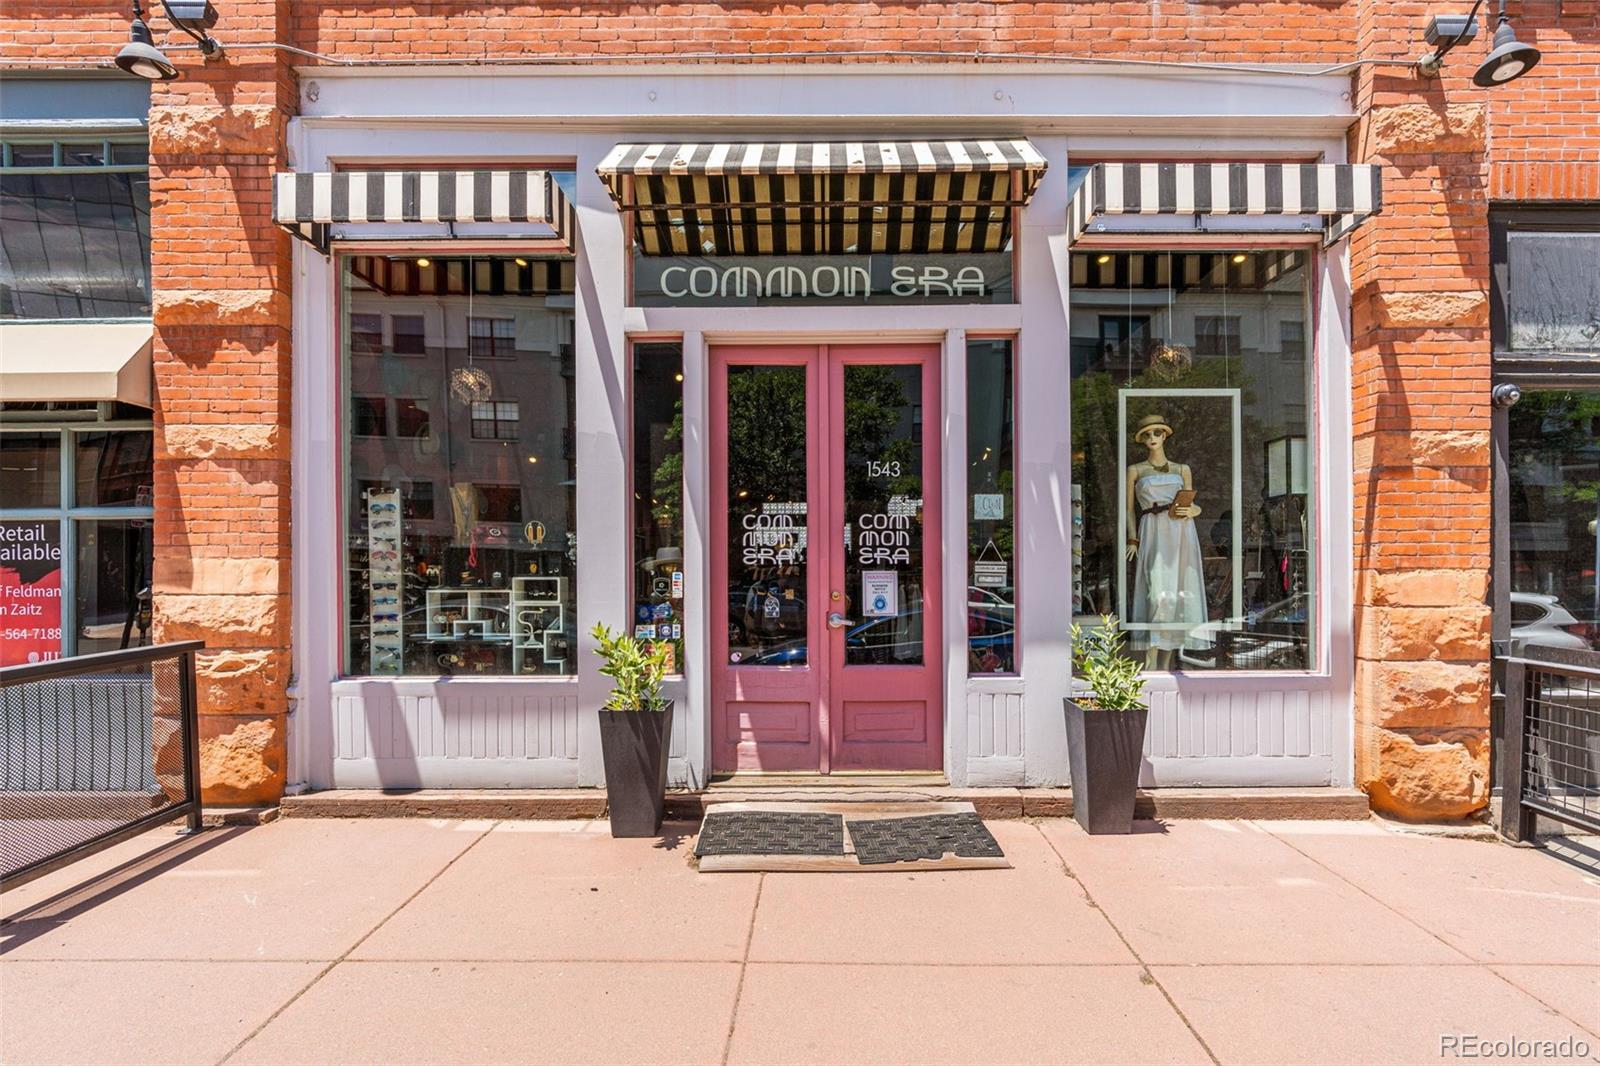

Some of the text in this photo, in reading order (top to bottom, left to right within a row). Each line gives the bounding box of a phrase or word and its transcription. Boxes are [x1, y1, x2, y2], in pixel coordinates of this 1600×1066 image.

[660, 266, 985, 298] COMMON ERA
[866, 461, 901, 477] 1543
[742, 514, 793, 530] COM
[859, 513, 910, 530] COM
[0, 524, 46, 541] Retail
[742, 531, 793, 547] MON
[859, 530, 910, 546] MON
[742, 548, 794, 565] ERA
[859, 547, 910, 565] ERA
[5, 585, 62, 598] Feldman
[10, 603, 43, 616] Zaitz
